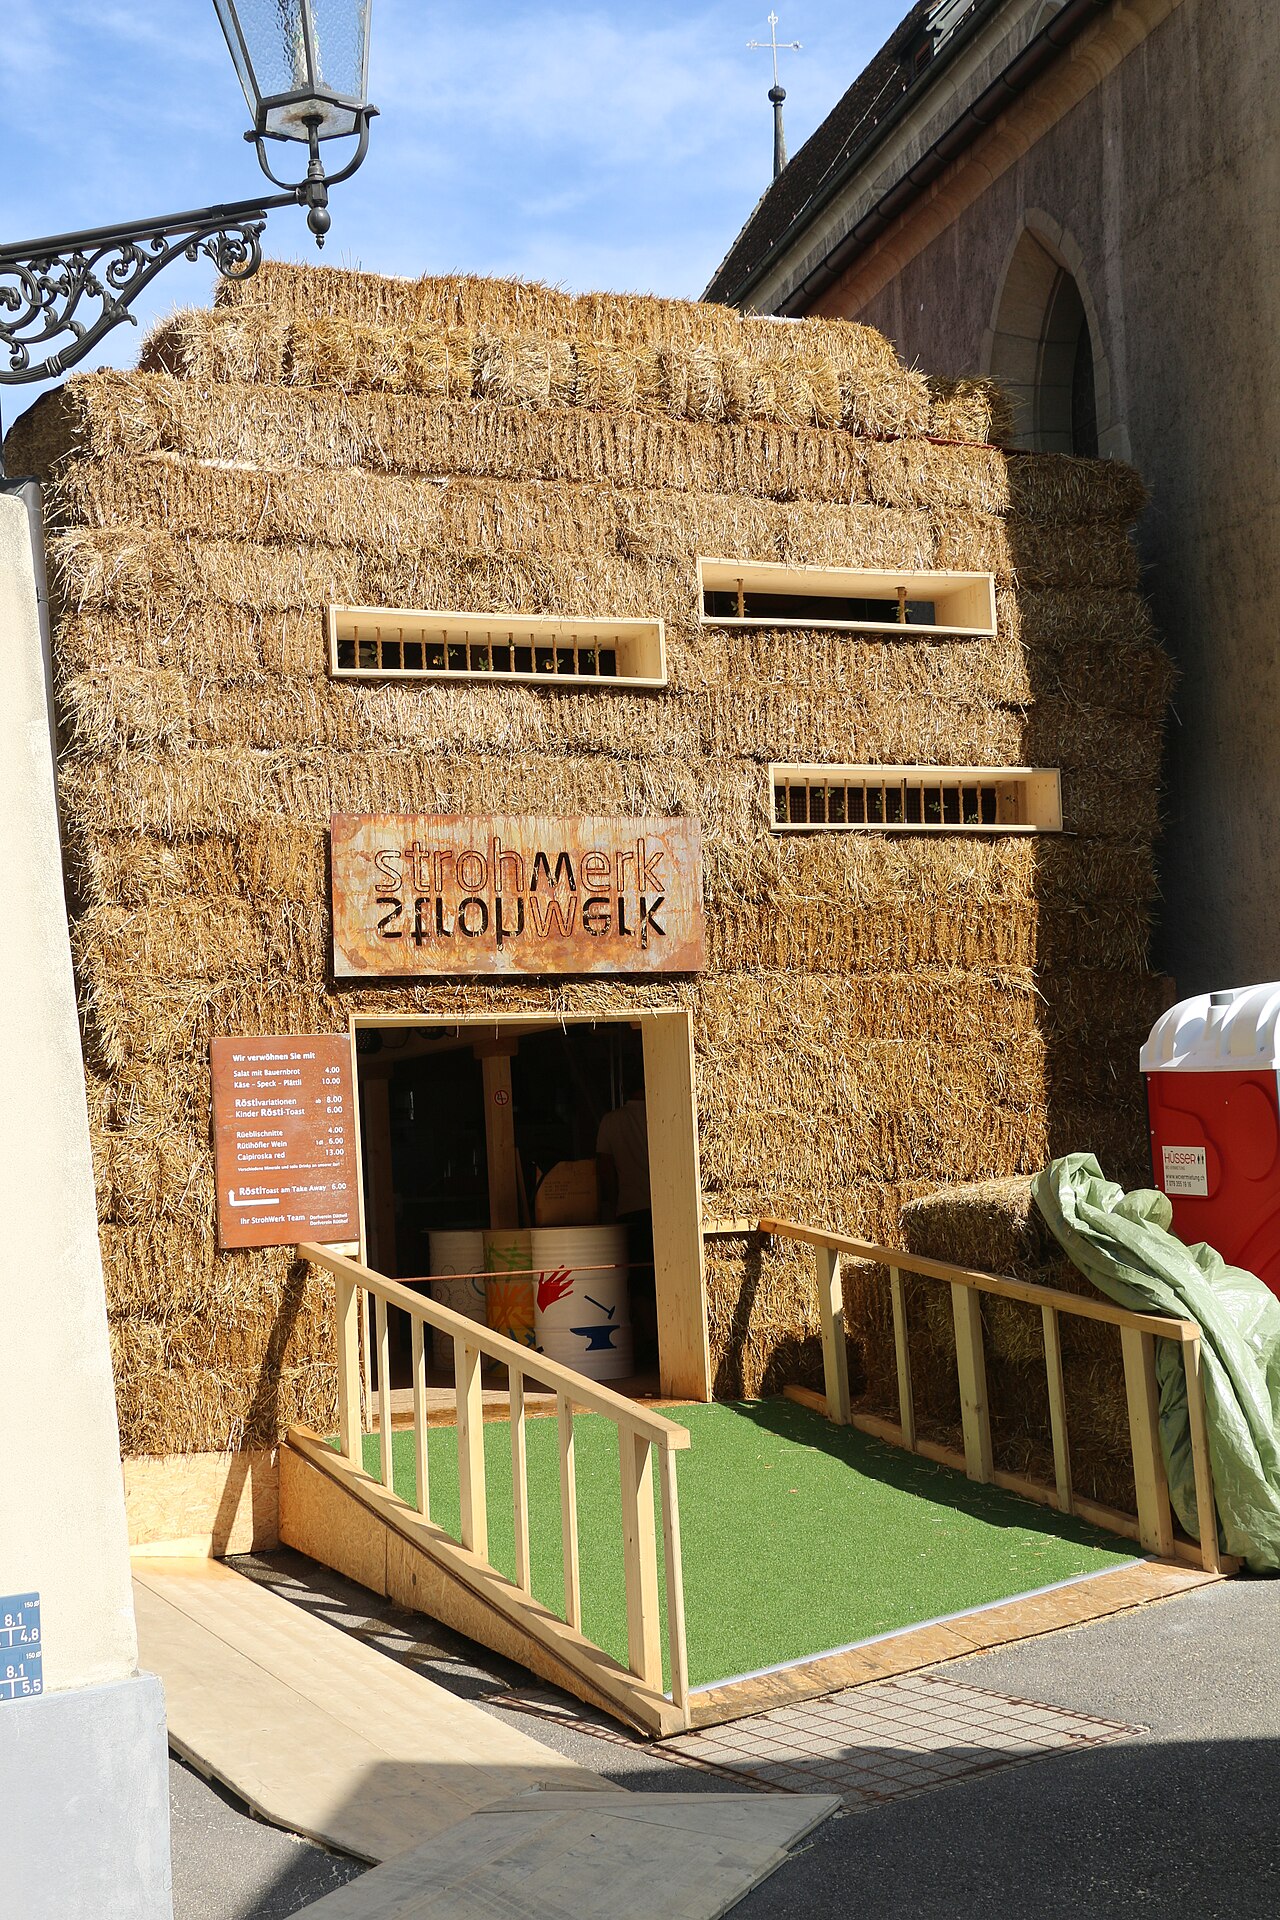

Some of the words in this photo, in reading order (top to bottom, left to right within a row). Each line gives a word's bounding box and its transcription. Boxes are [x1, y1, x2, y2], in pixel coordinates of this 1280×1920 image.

[232, 1054, 246, 1062] Wir
[247, 1053, 289, 1061] verwöhnen
[290, 1052, 301, 1060] Sie
[303, 1052, 316, 1060] mit
[233, 1070, 250, 1078] Salat
[325, 1066, 340, 1074] 4.00
[234, 1081, 251, 1089] Käse
[257, 1080, 276, 1089] Speck
[283, 1079, 302, 1087] Plättli
[235, 1098, 297, 1108] Röstivariationen
[326, 1096, 343, 1104] 8.00
[260, 1108, 305, 1117] Rösti-Toast
[326, 1106, 343, 1114] 6.00
[236, 1130, 284, 1139] Rüeblischnitte
[270, 1140, 288, 1148] Wein
[237, 1152, 273, 1162] Caipiroska
[239, 1186, 280, 1196] RöstiToast
[291, 1185, 309, 1193] Take
[308, 1184, 328, 1193] Away
[331, 1183, 347, 1191] 6.00
[240, 1217, 251, 1225] Ihr
[251, 1215, 286, 1225] StrohWerk
[287, 1214, 306, 1222] Team
[4, 1612, 23, 1627] 8,1
[20, 1628, 39, 1642] 4,8
[6, 1663, 25, 1678] 8,1
[22, 1679, 41, 1694] 5,5
